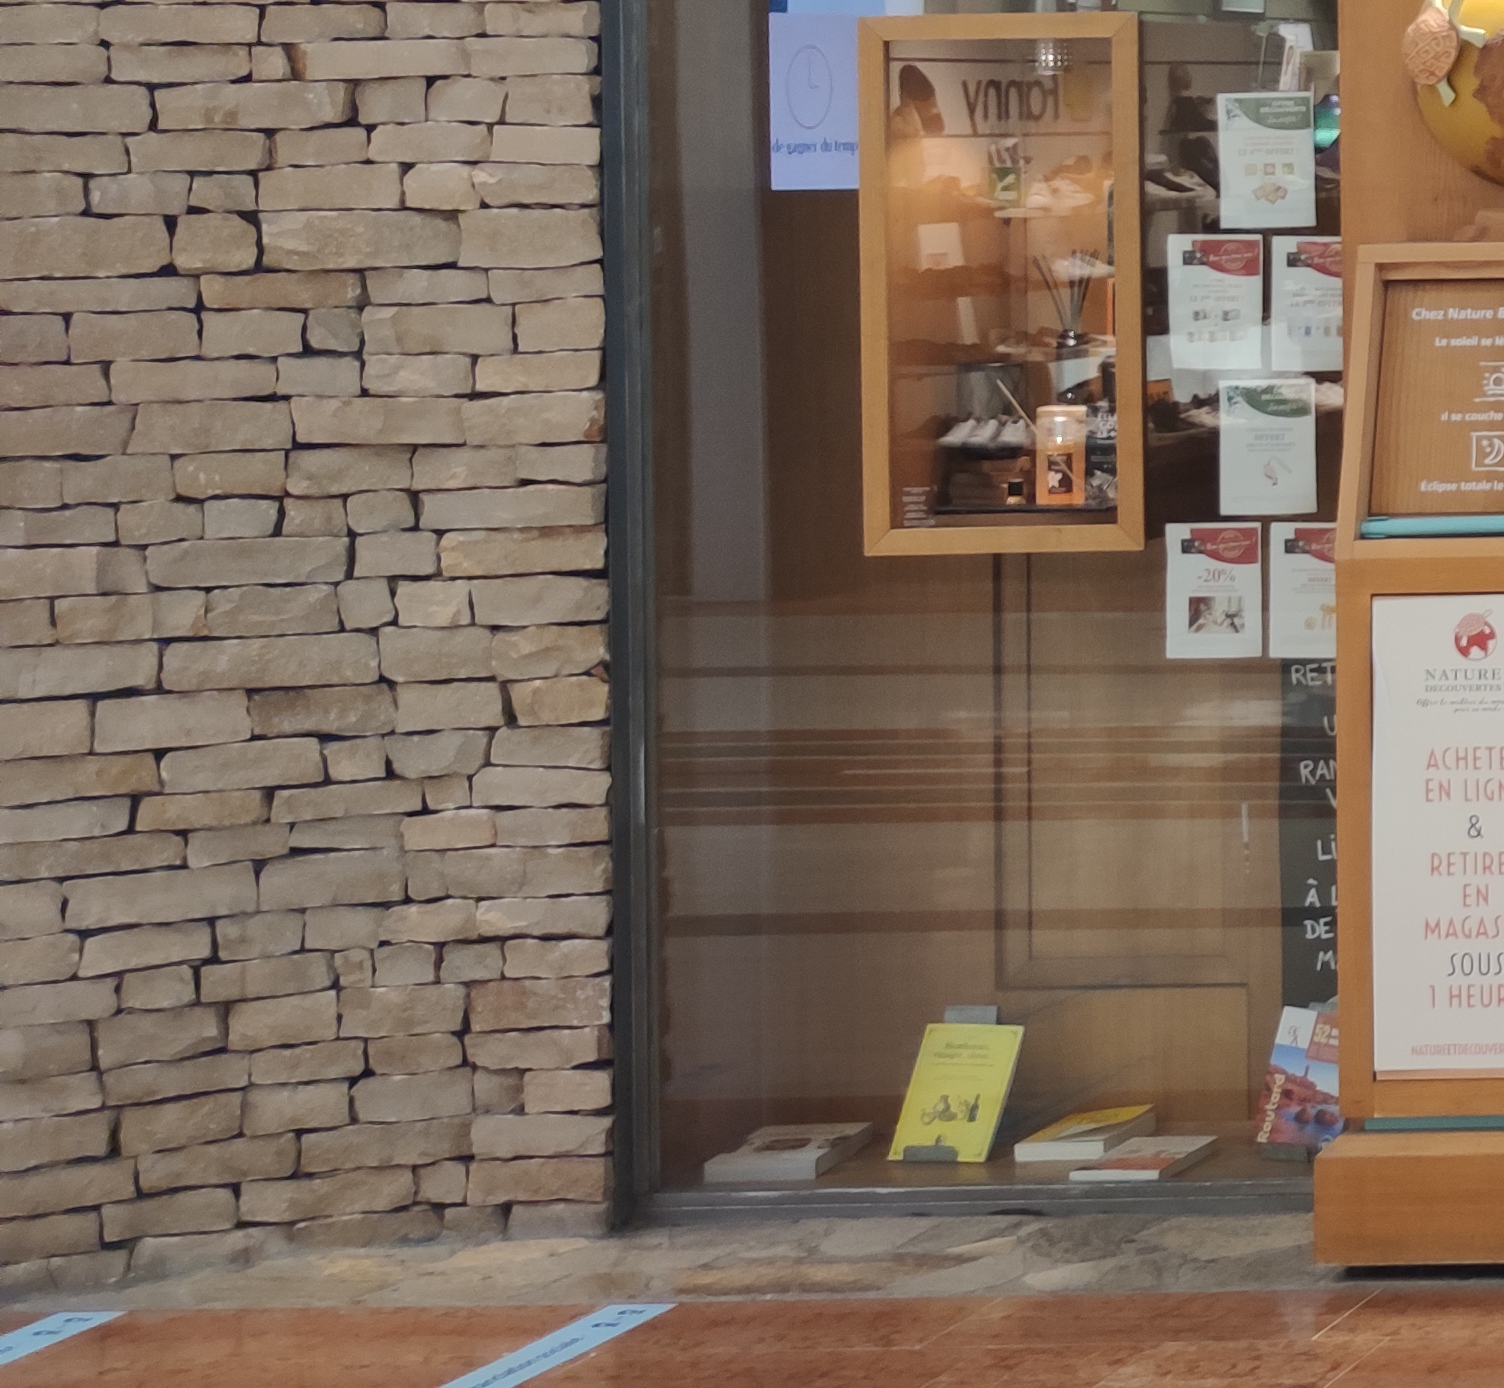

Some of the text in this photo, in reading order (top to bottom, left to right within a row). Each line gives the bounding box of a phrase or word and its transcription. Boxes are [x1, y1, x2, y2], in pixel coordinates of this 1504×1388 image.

[1412, 307, 1444, 321] Chez
[1448, 307, 1494, 320] Nature
[1435, 336, 1448, 347] Le
[1451, 335, 1478, 347] soleil
[1481, 337, 1493, 347] se
[1451, 412, 1463, 422] se
[1465, 410, 1504, 422] couche
[1420, 480, 1457, 493] Éclipse
[1460, 480, 1493, 491] totale
[1494, 480, 1503, 490] le
[1197, 568, 1236, 583] -20%
[1424, 667, 1502, 681] NATURE
[1425, 777, 1451, 803] EN
[1467, 814, 1484, 840] &
[1462, 883, 1490, 908] EN
[1429, 984, 1436, 1009] 1
[1313, 1023, 1331, 1044] 52
[1255, 1073, 1286, 1143] Routard
